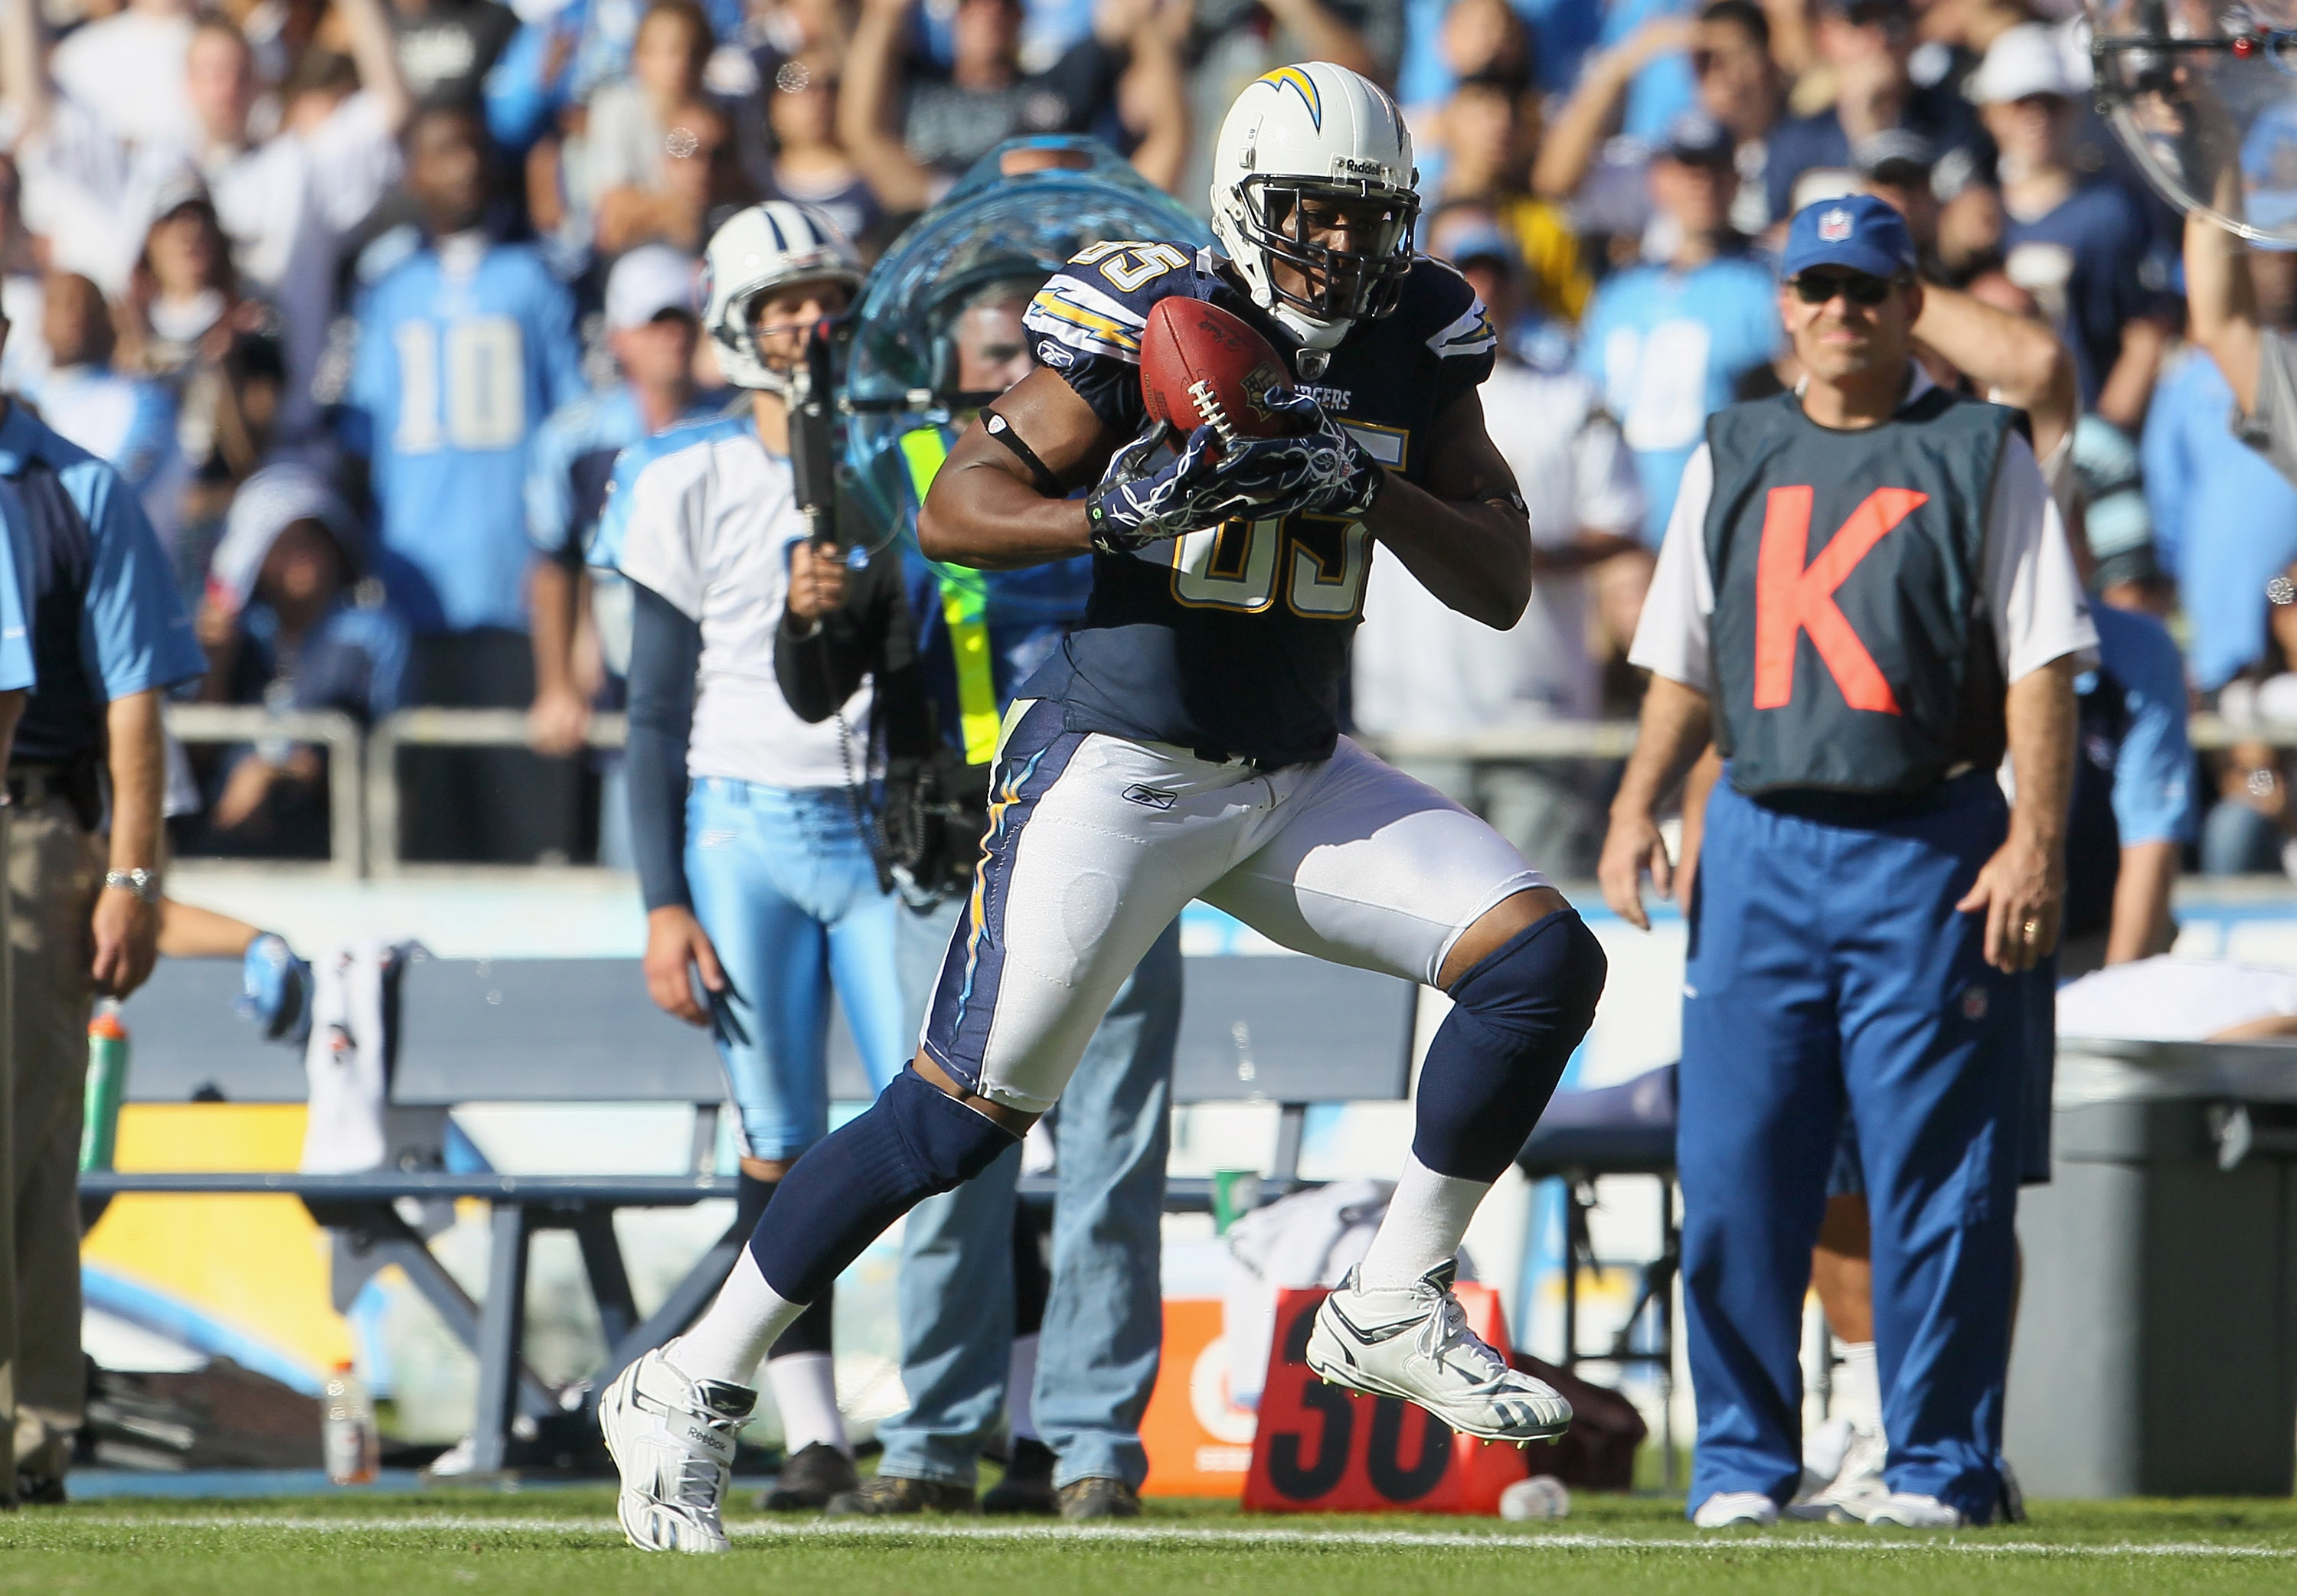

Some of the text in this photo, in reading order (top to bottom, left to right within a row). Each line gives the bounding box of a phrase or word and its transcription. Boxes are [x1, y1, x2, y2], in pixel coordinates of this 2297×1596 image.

[1347, 158, 1382, 177] Riddell
[391, 315, 524, 455] 10
[1753, 485, 1930, 716] K
[687, 1426, 727, 1454] Reebok
